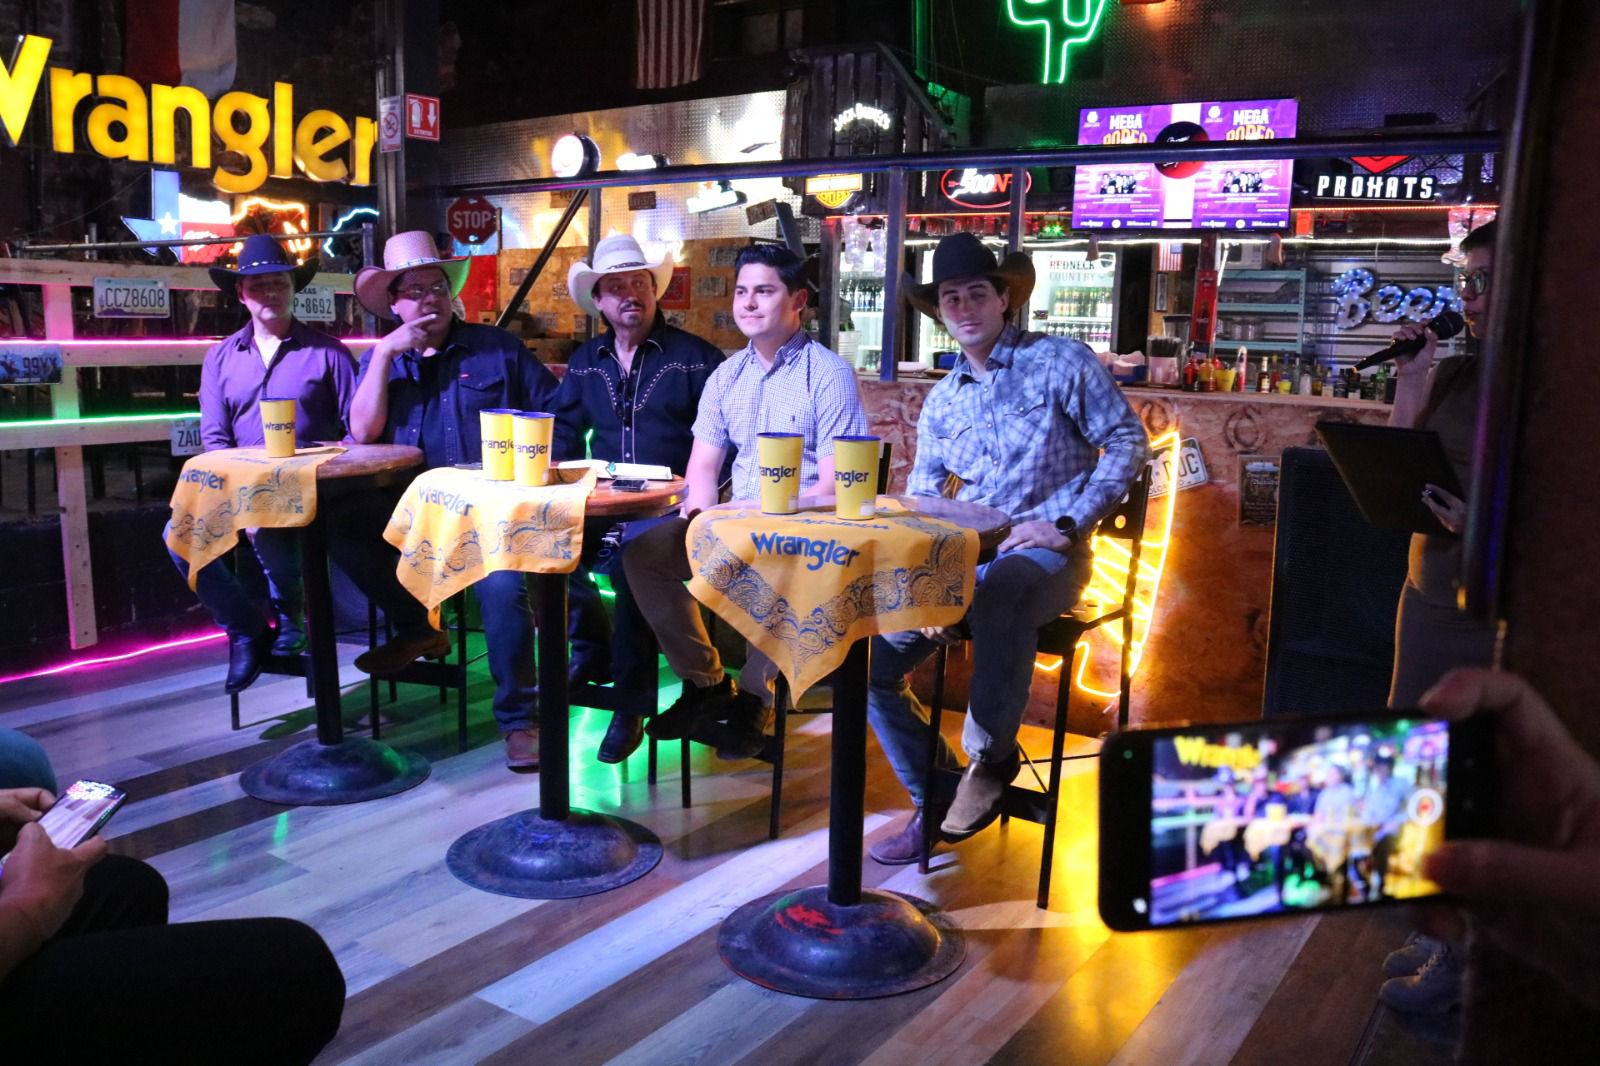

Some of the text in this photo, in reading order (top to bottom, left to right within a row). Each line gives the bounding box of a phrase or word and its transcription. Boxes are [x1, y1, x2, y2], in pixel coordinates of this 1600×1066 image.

[1109, 114, 1142, 130] MEGA
[1233, 109, 1269, 125] MEGA
[1317, 175, 1434, 199] PROHATS
[453, 210, 491, 229] STOP
[105, 287, 165, 308] CCZ8608
[751, 531, 860, 571] Wrangler
